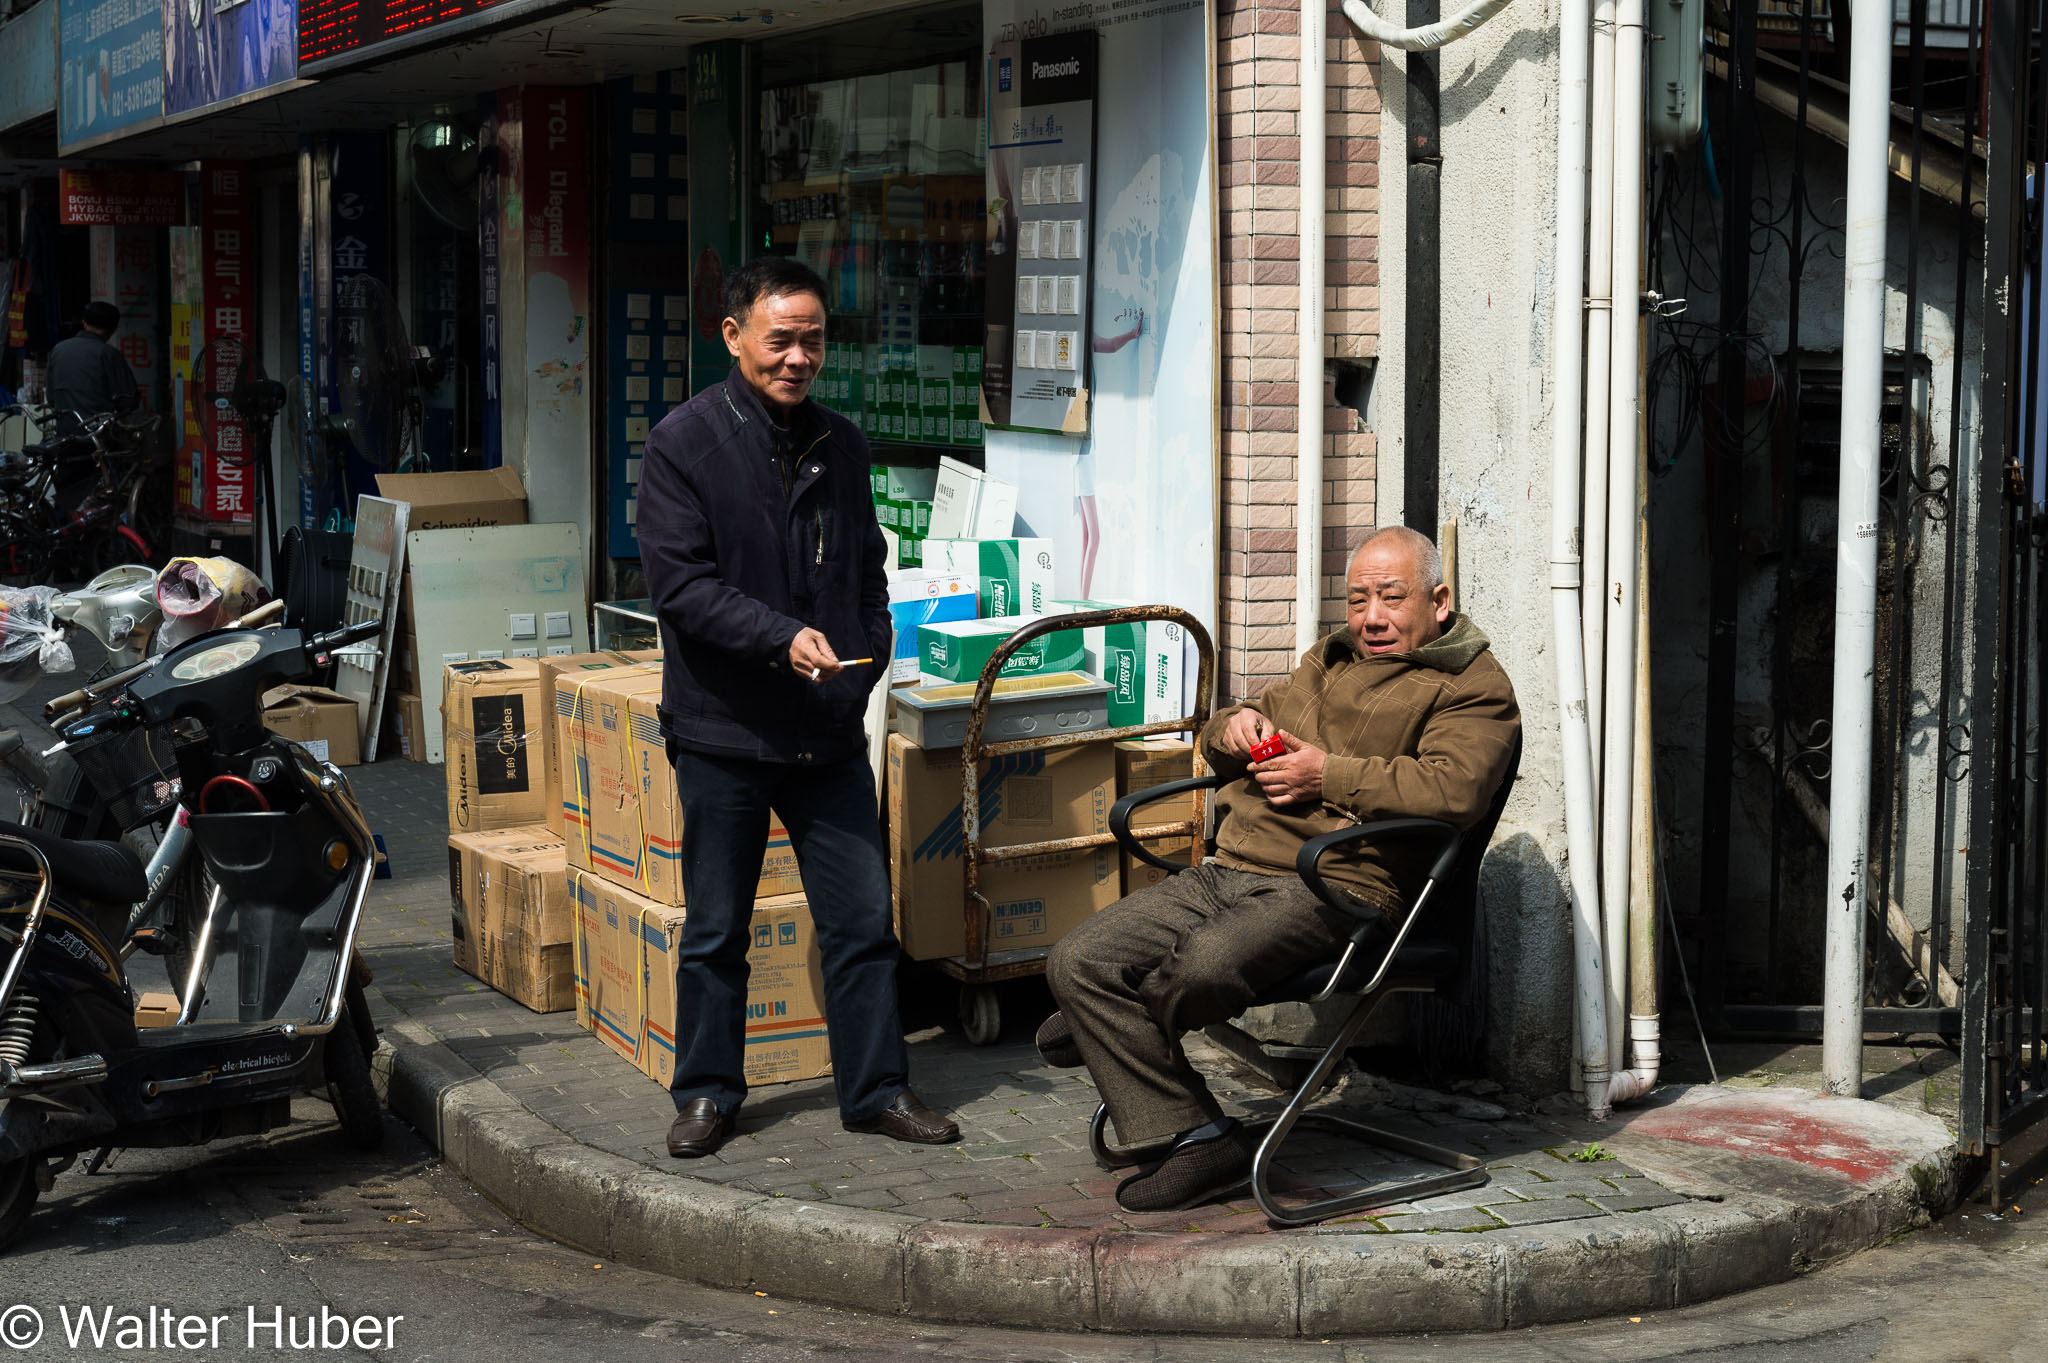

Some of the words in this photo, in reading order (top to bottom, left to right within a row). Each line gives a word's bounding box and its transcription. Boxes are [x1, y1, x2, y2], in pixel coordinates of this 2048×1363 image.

[695, 51, 718, 85] 394
[1032, 56, 1080, 80] Panasonic
[548, 98, 569, 151] TCL
[68, 195, 103, 205] BCMJ
[543, 189, 569, 257] legrand
[994, 583, 1006, 618] Nedfo
[1007, 655, 1041, 668] 绿岛风
[1119, 654, 1131, 696] 绿岛风
[506, 757, 517, 780] 美的
[129, 864, 171, 923] MERIDA
[222, 1056, 262, 1072] electrical
[263, 1052, 292, 1067] bicycle
